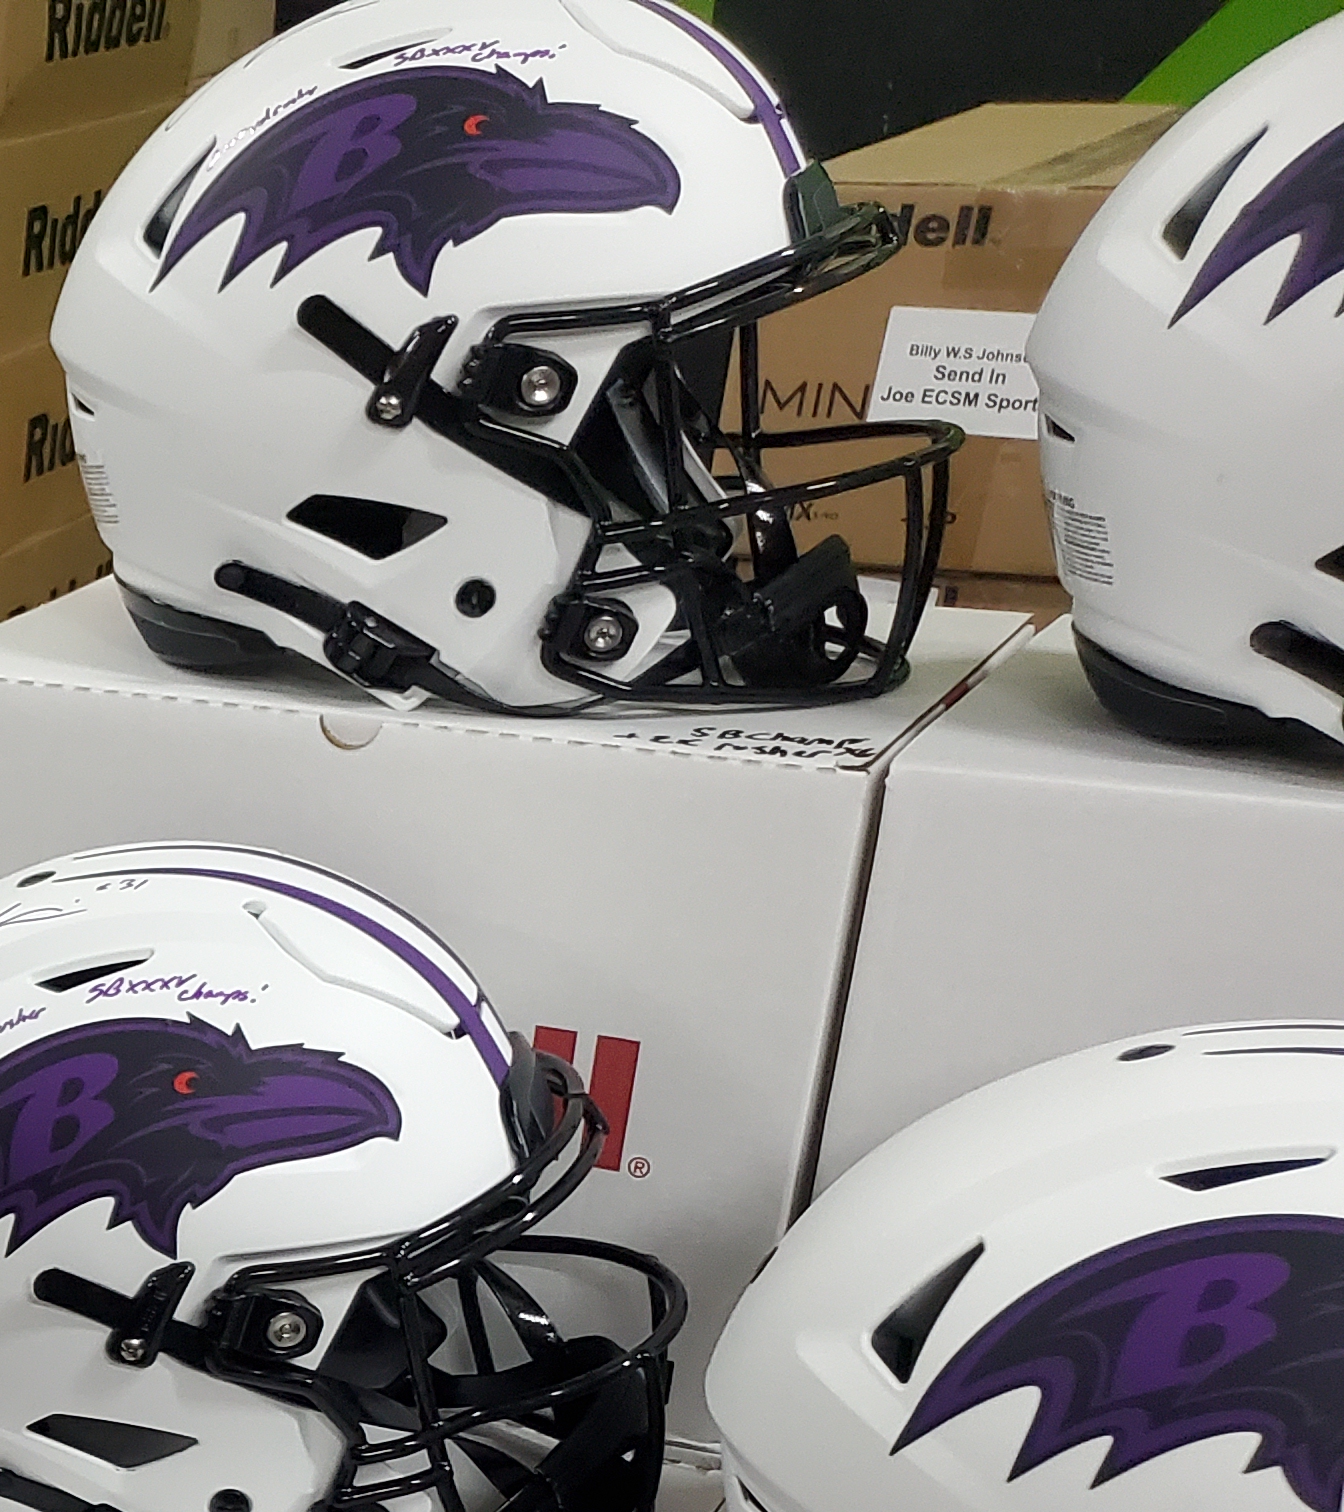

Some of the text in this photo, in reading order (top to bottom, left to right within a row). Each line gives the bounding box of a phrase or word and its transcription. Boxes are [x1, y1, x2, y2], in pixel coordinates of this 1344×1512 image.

[46, 0, 165, 62] Riddell
[909, 344, 941, 360] Billy
[945, 346, 973, 360] W.S
[933, 365, 1006, 386] Send In
[880, 386, 914, 403] Joe
[921, 389, 979, 407] ECSM
